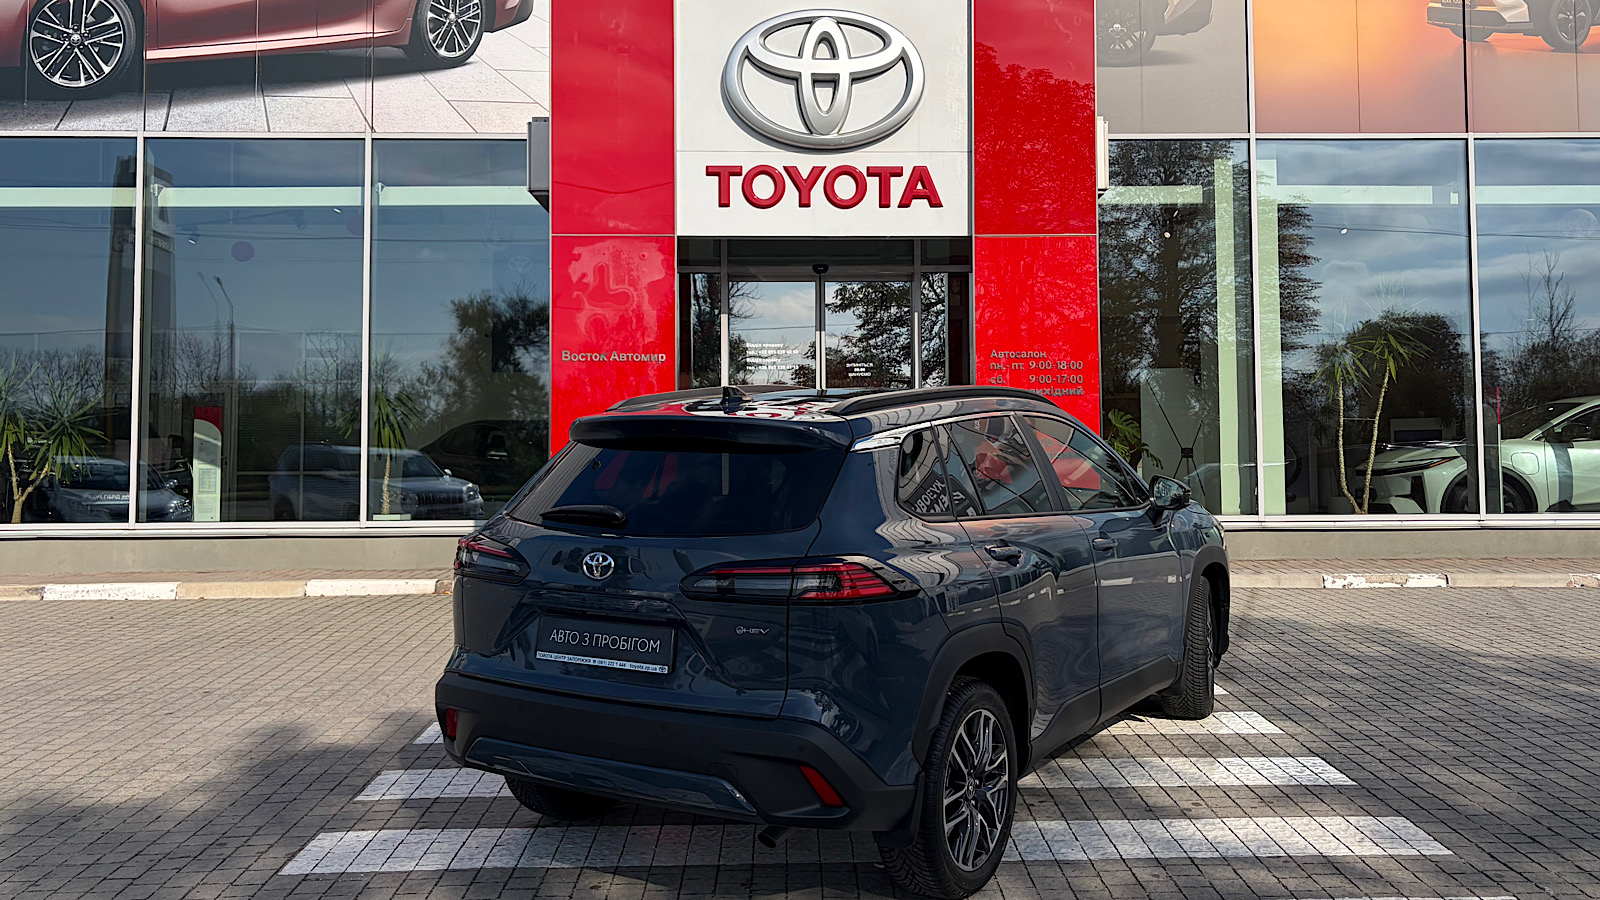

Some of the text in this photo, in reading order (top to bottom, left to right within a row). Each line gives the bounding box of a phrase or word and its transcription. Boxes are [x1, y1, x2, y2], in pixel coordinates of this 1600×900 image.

[705, 164, 944, 209] TOYOTA
[561, 350, 667, 364] Восток Автомир
[990, 349, 1047, 359] Автосалон
[1029, 360, 1084, 370] 9:00-18:00
[1029, 374, 1084, 384] 9:00-17:00
[549, 628, 580, 645] АВТО
[592, 633, 661, 654] ПРОБІГОМ
[629, 663, 658, 672] toyota.zp.ua
